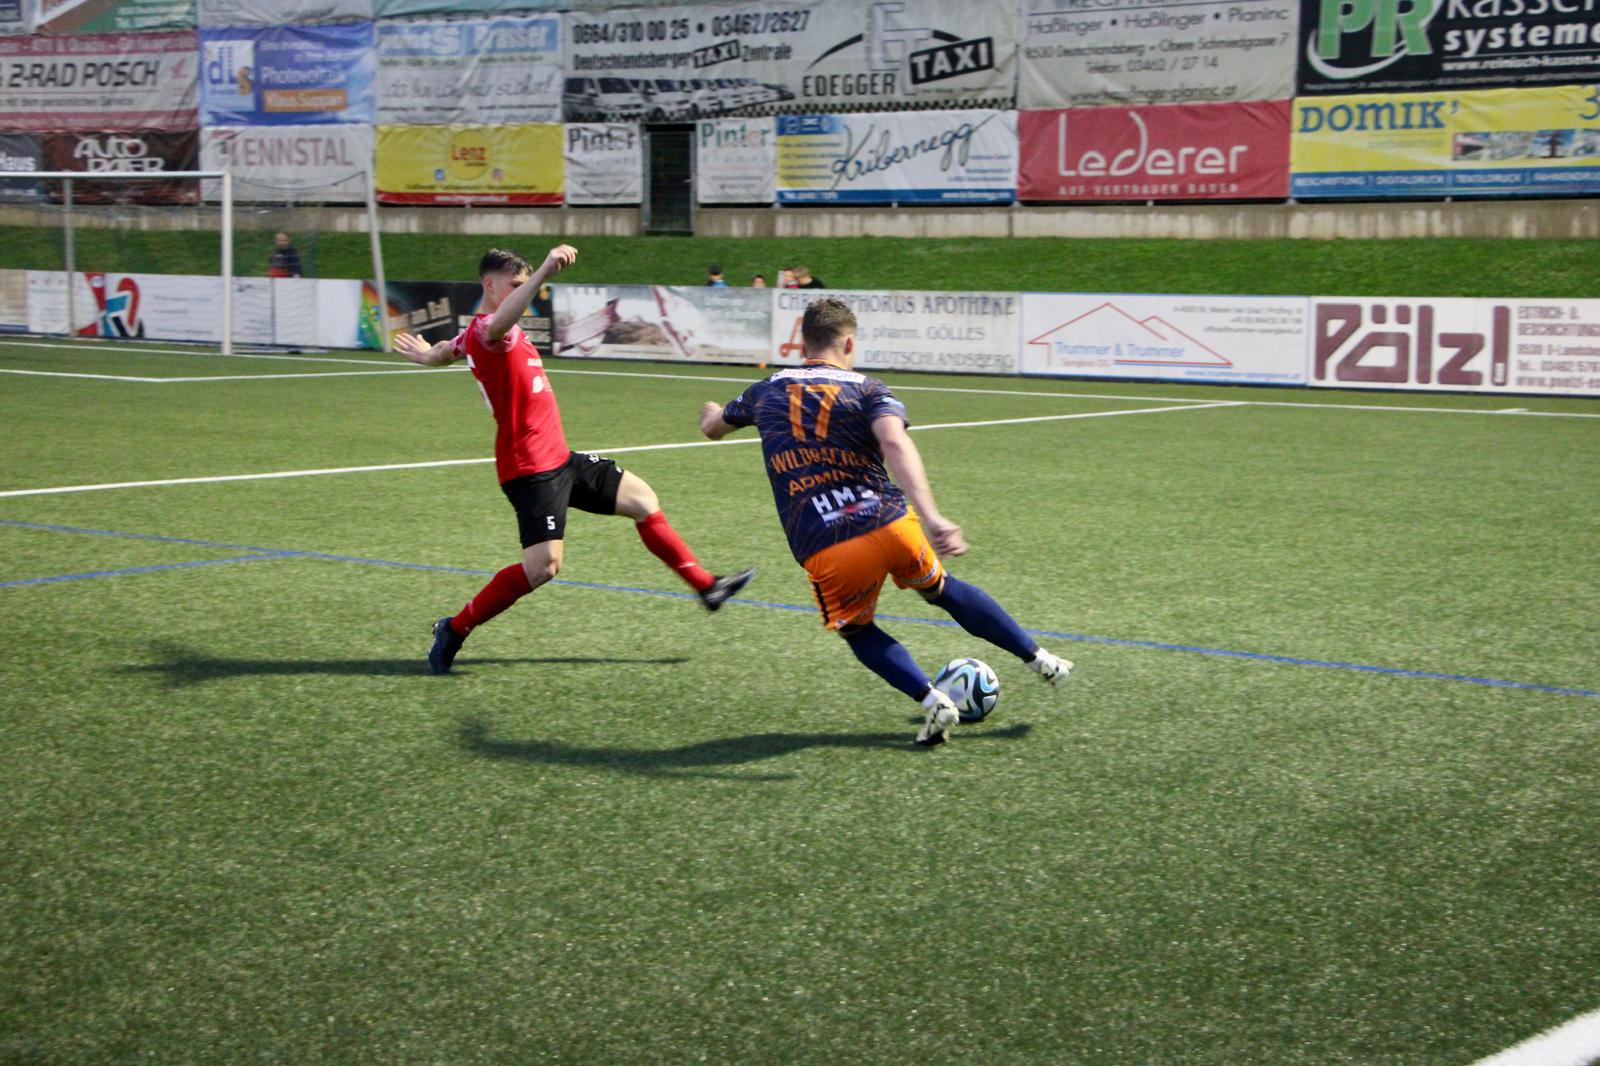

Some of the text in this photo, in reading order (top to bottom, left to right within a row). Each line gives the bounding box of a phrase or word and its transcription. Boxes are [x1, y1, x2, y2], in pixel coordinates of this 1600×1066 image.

[1228, 7, 1289, 22] Planinc
[647, 19, 666, 41] 00
[671, 18, 690, 41] 25
[1318, 0, 1434, 58] PR
[696, 42, 739, 67] TAXI
[742, 43, 793, 62] Zentrale
[912, 41, 991, 80] TAXI
[8, 60, 161, 88] 2-RAD POSCH
[802, 73, 896, 97] EDEGGER
[568, 126, 635, 153] Pintr
[1058, 111, 1248, 177] Lederer
[1059, 184, 1086, 196] AUF
[922, 295, 1016, 315] APOTHEKE
[864, 350, 1015, 369] DEUTSCHLANDSBERG
[786, 384, 842, 442] 17
[546, 515, 556, 531] 5
